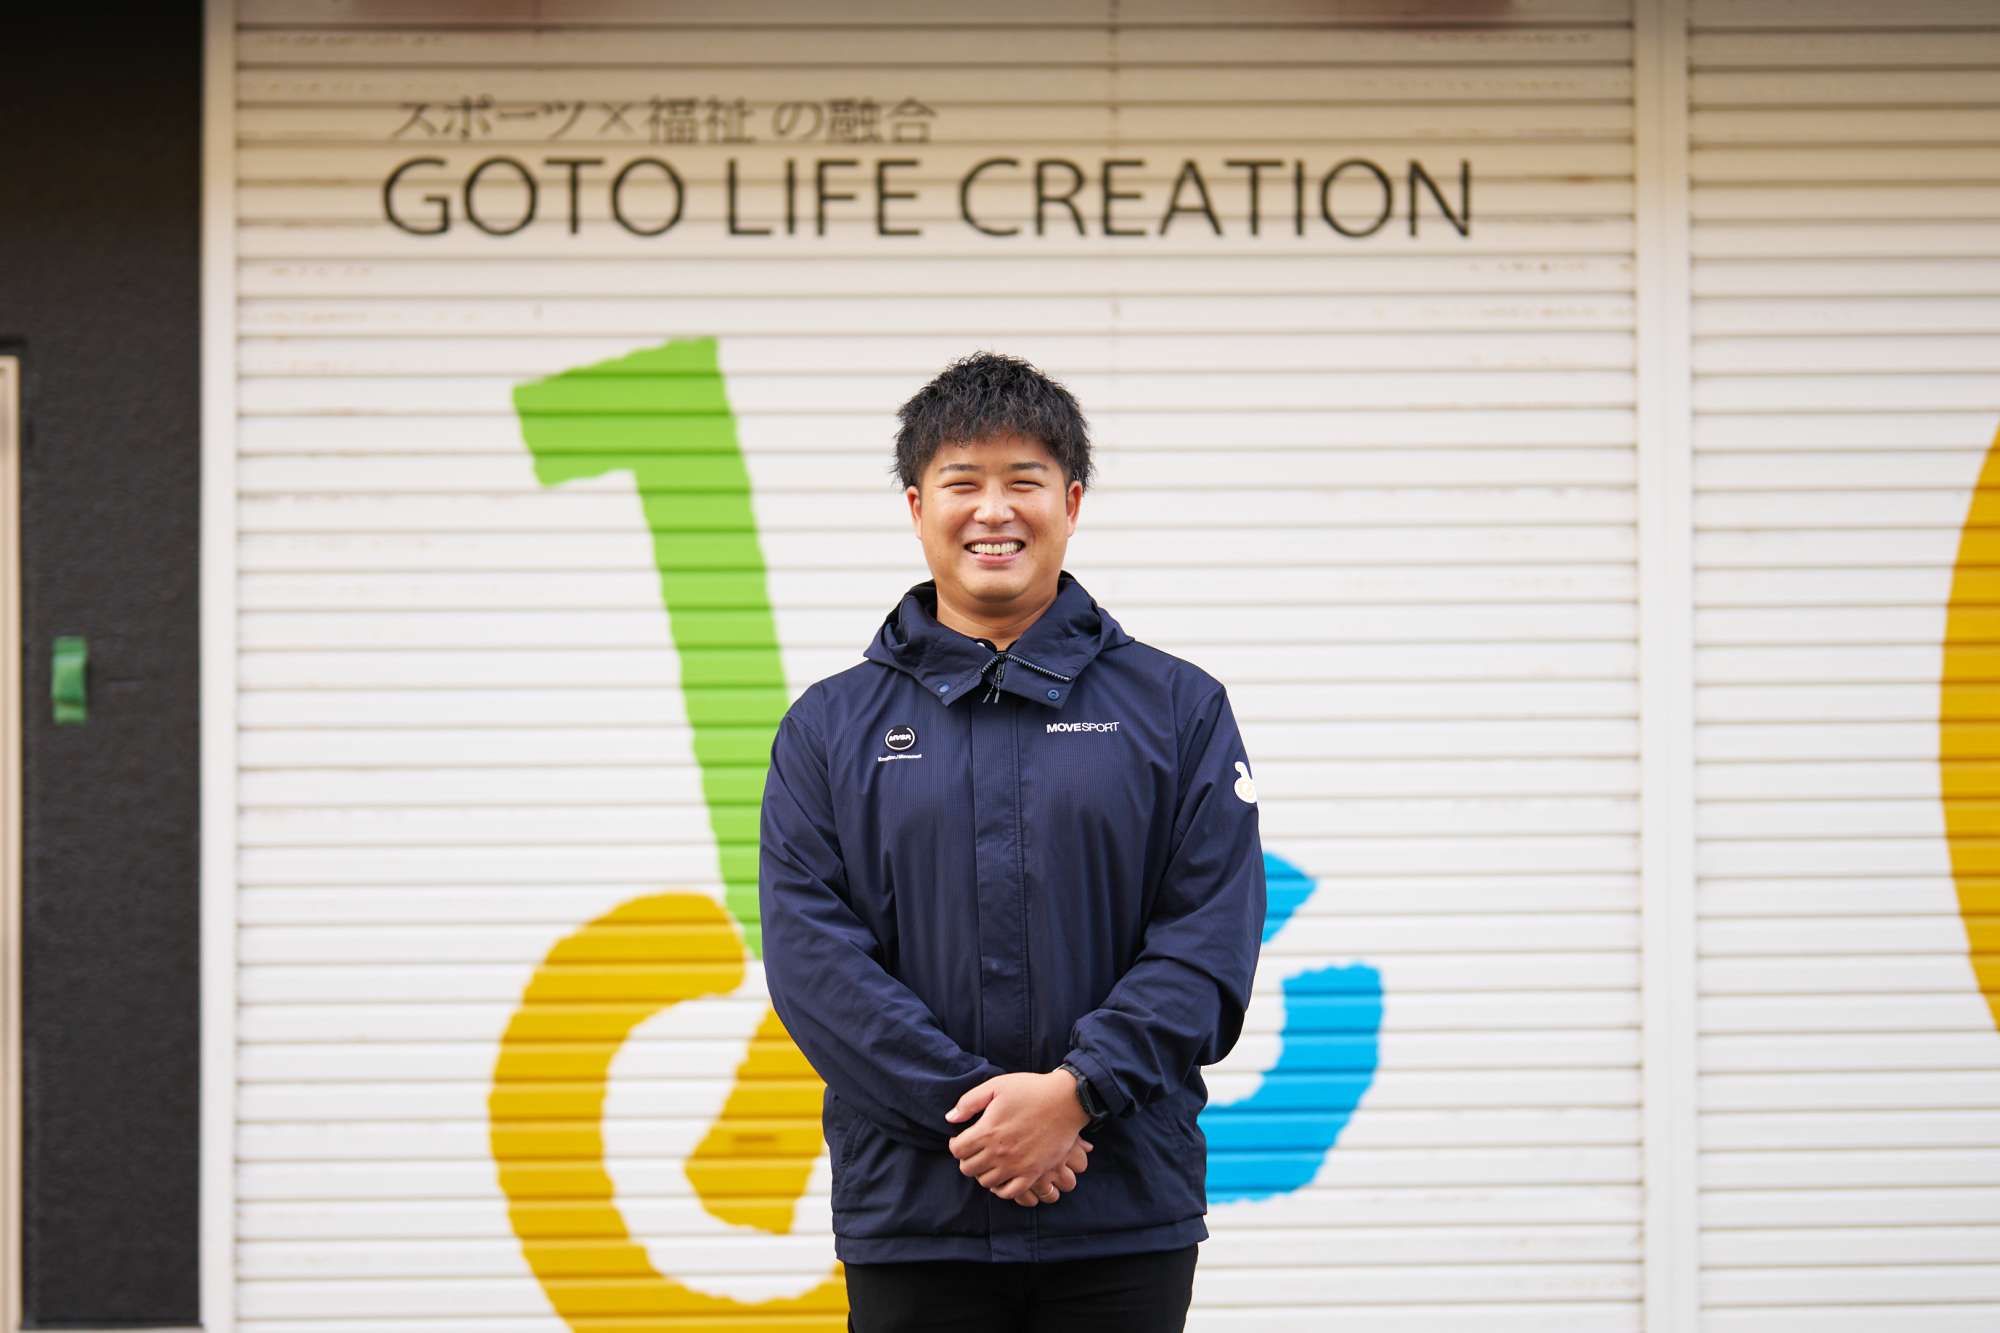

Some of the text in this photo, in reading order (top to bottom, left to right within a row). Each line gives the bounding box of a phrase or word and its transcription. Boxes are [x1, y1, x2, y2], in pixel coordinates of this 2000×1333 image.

[383, 155, 1472, 237] GOTO LIFE CREATION
[1046, 721, 1120, 733] MOVESPORT
